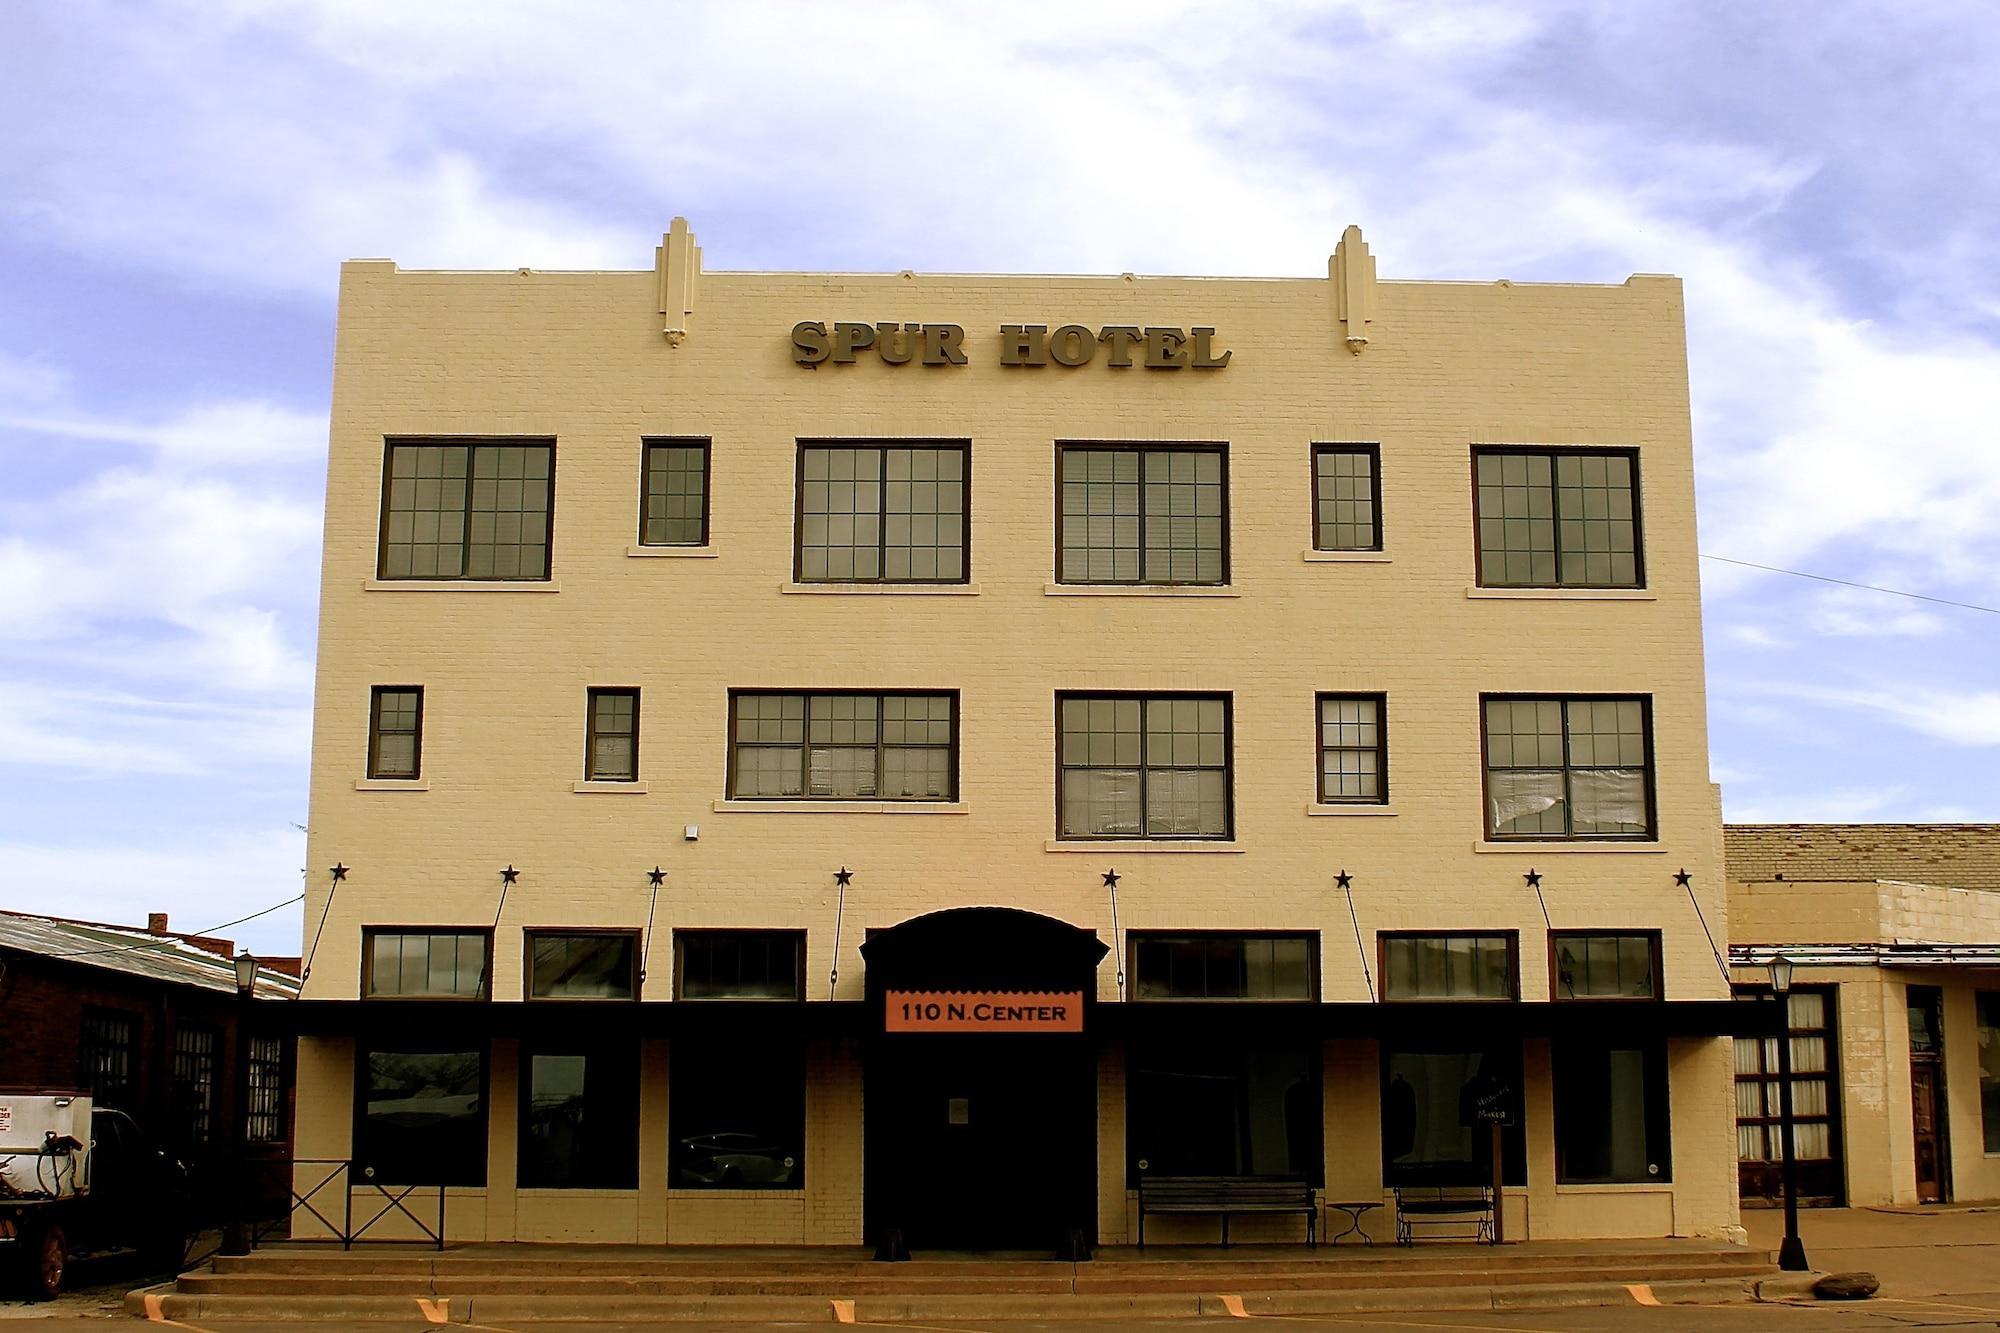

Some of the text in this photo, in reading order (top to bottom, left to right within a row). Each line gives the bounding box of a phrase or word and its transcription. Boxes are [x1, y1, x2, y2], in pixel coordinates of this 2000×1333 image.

[791, 321, 1233, 368] SPUR HOTEL
[902, 1003, 941, 1021] 110
